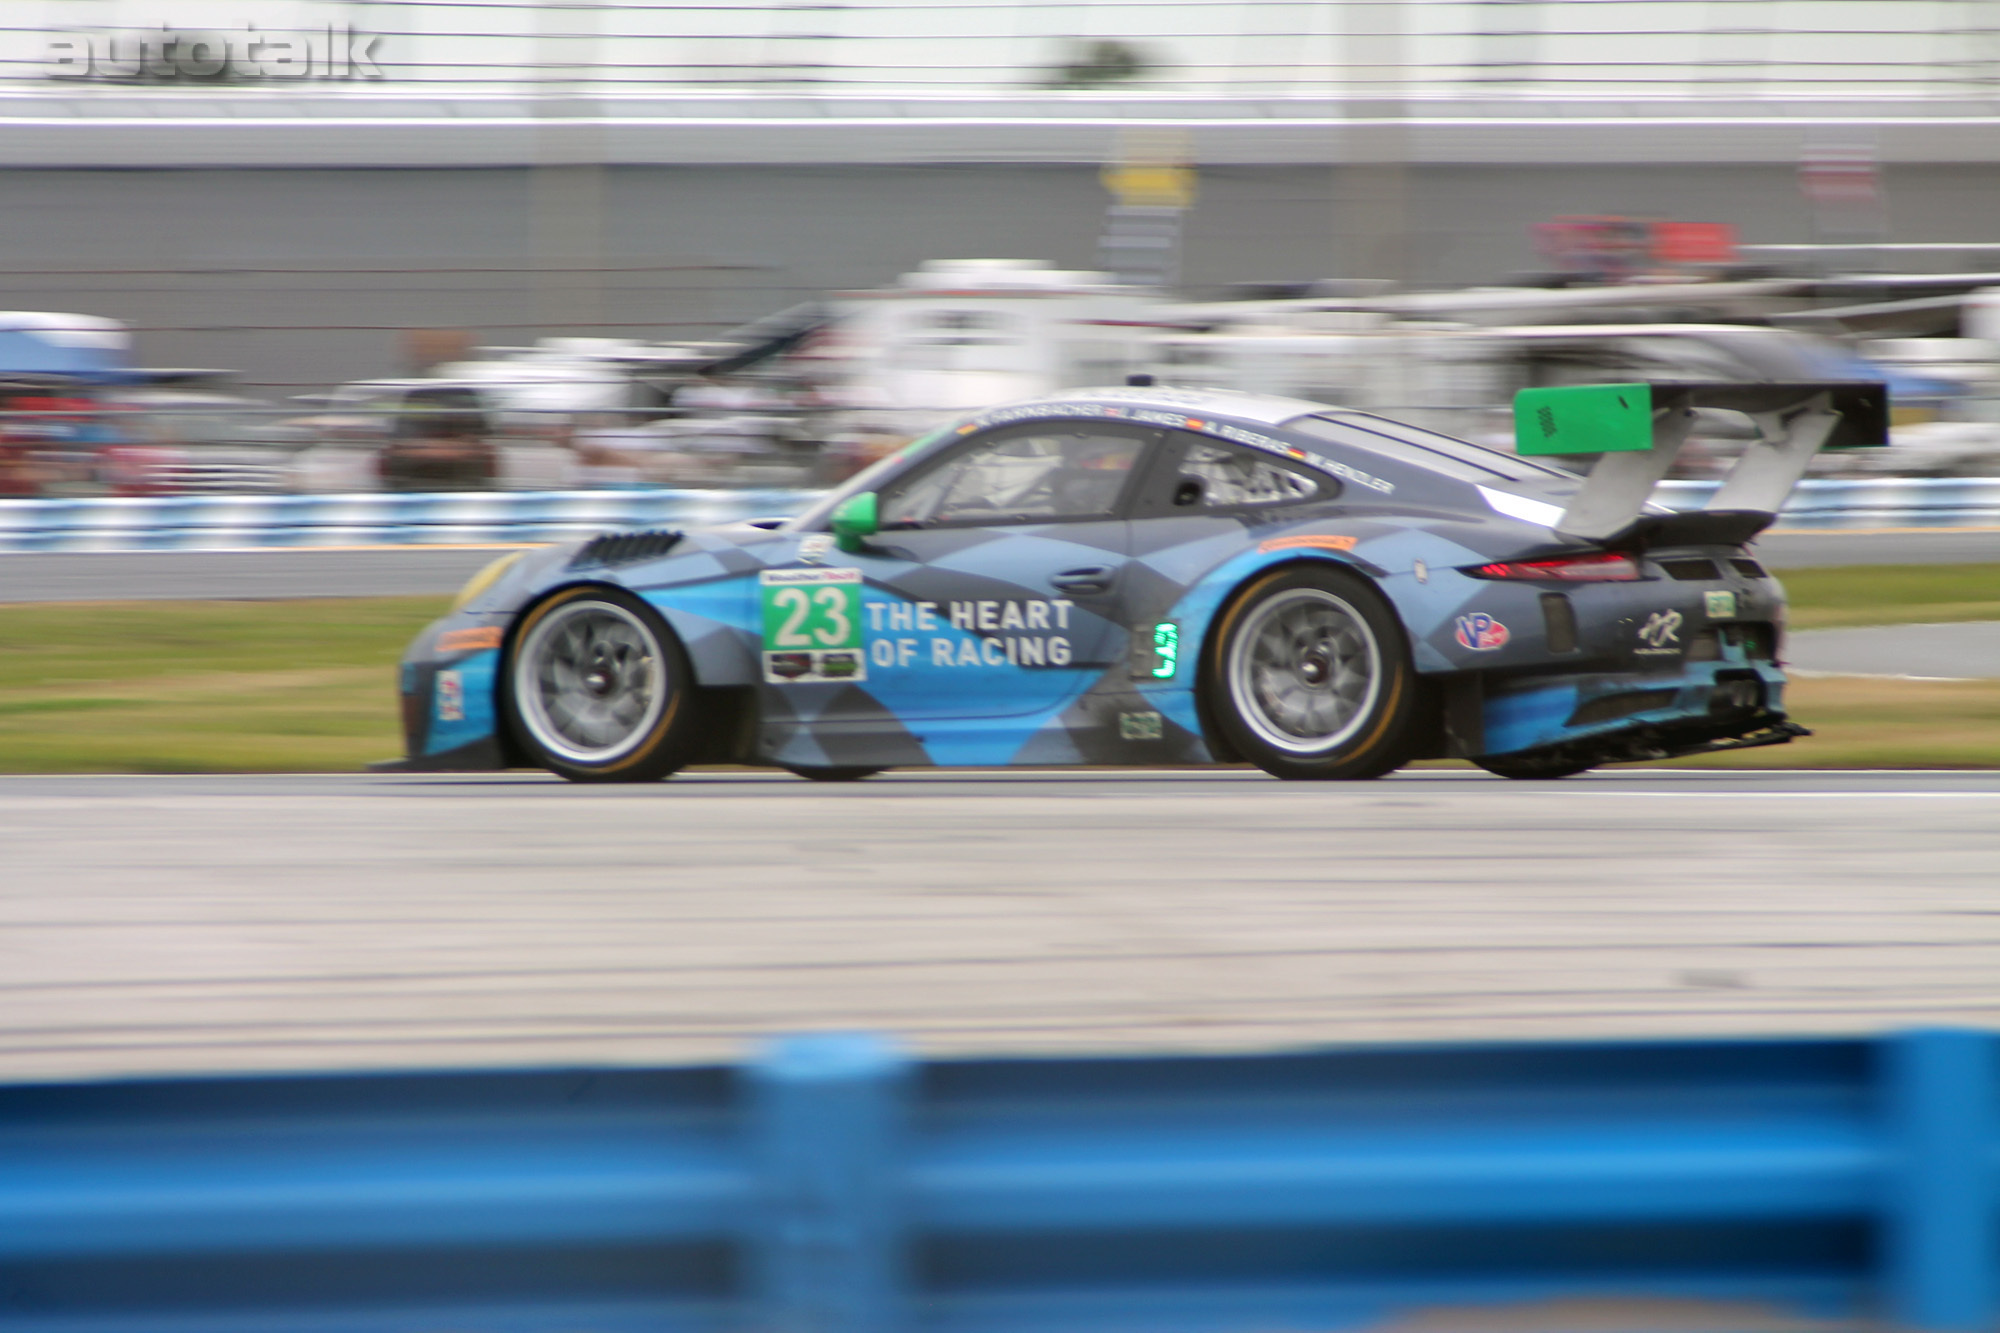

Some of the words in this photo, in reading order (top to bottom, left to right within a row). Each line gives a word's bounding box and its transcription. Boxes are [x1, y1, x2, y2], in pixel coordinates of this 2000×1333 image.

[773, 586, 852, 647] 23
[865, 601, 938, 631] THE
[950, 600, 1075, 630] HEART
[871, 637, 919, 668] OF
[931, 636, 1072, 667] RACING
